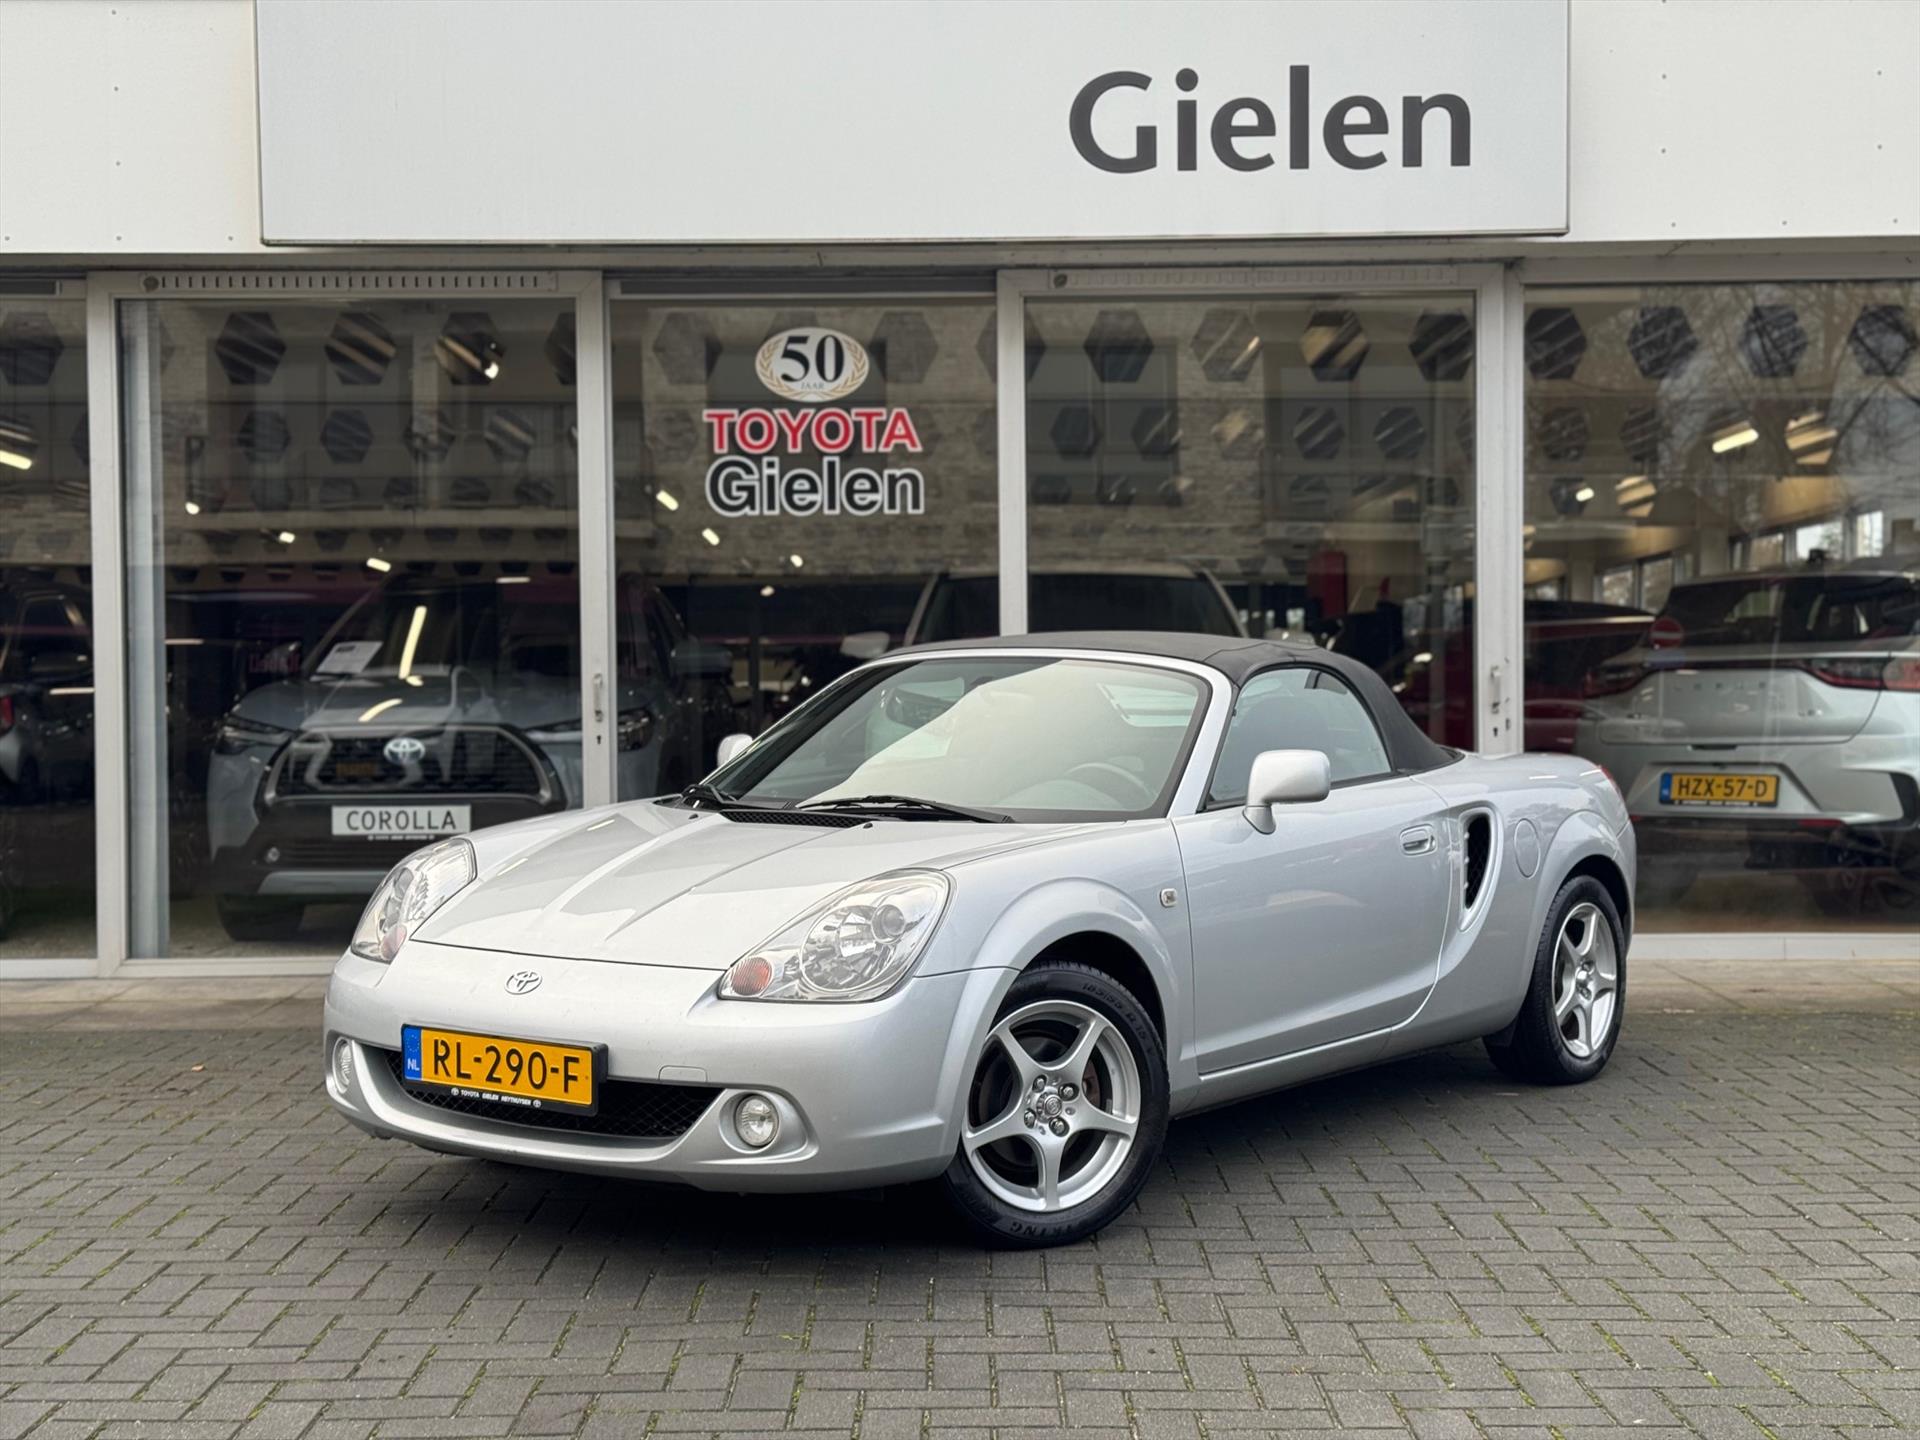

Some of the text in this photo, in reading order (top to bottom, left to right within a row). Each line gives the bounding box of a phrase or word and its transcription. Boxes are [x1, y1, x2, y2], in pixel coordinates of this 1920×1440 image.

[1069, 64, 1471, 174] Gielen
[781, 334, 845, 383] 50
[801, 382, 825, 390] JAAR
[703, 408, 923, 454] TOYOTA
[705, 456, 925, 517] Gielen
[1677, 778, 1769, 798] HZX-57-D
[346, 810, 457, 831] COROLLA
[407, 1058, 420, 1071] NL
[433, 1038, 580, 1094] RL-290-F
[460, 1089, 480, 1098] TOYOTA
